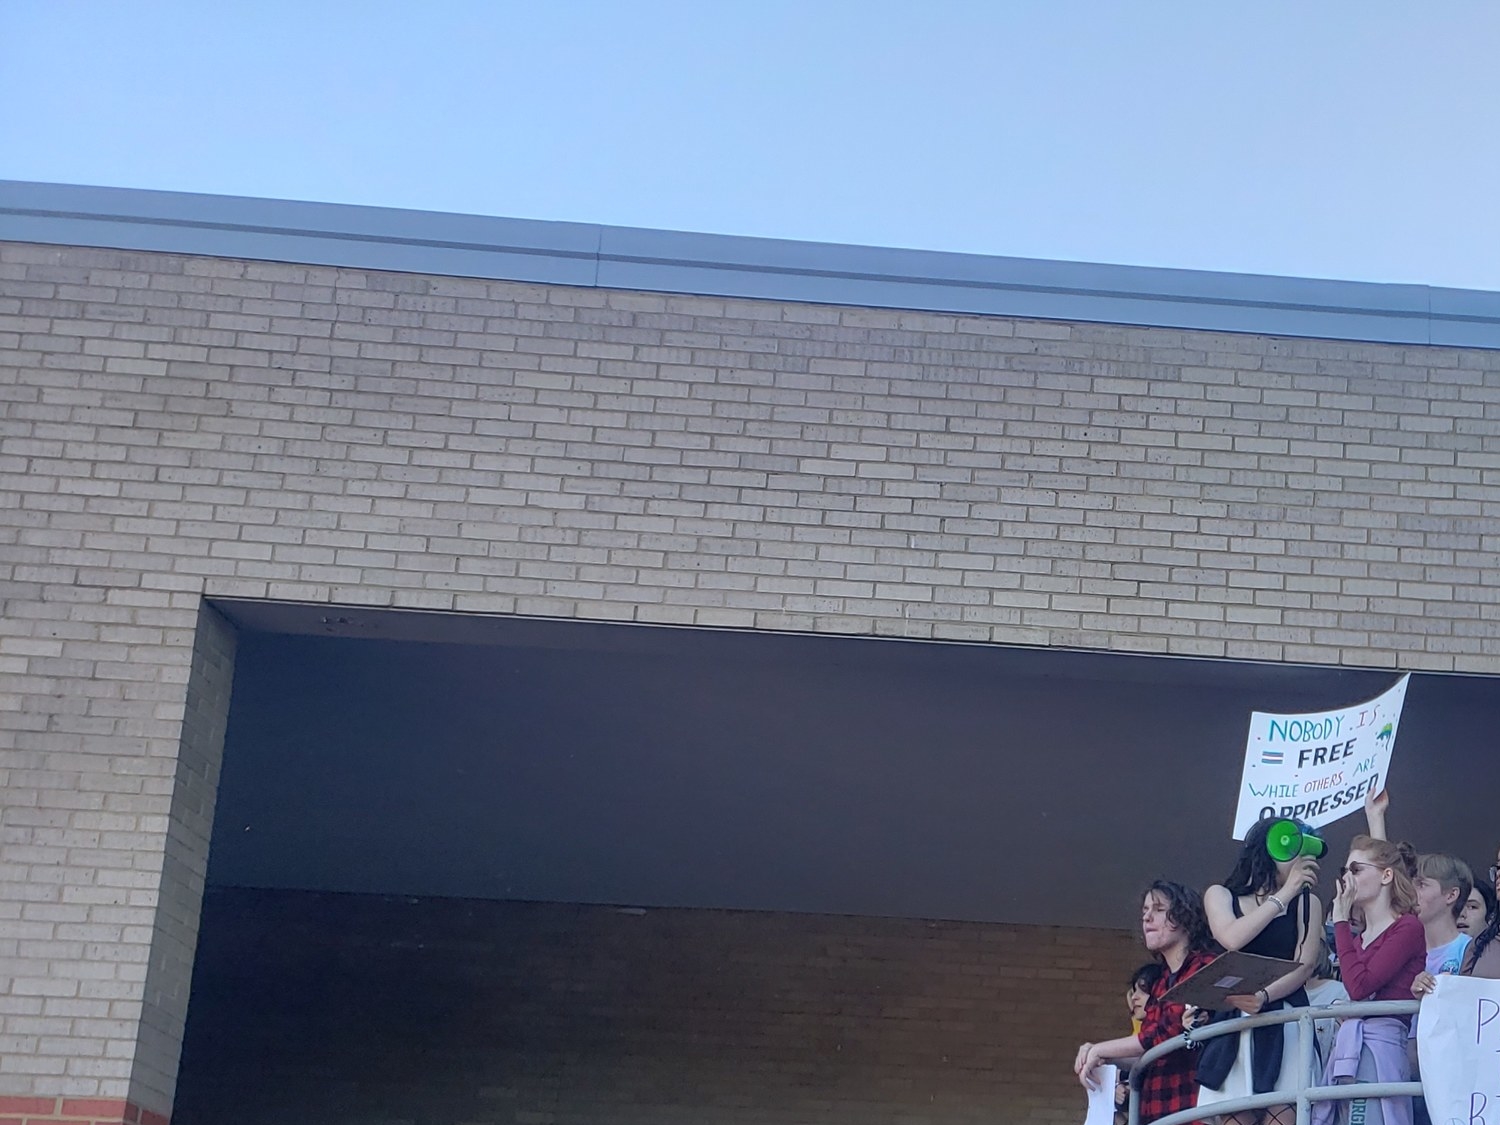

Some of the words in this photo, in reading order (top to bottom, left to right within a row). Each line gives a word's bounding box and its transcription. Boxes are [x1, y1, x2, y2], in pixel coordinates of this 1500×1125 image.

[1269, 715, 1345, 742] NOBODY
[1357, 704, 1380, 728] IS
[1298, 738, 1357, 768] FREE
[1249, 783, 1299, 798] WHILE
[1304, 771, 1344, 793] OTHERS
[1353, 754, 1377, 776] ARE
[1259, 773, 1379, 820] OPPRESSED
